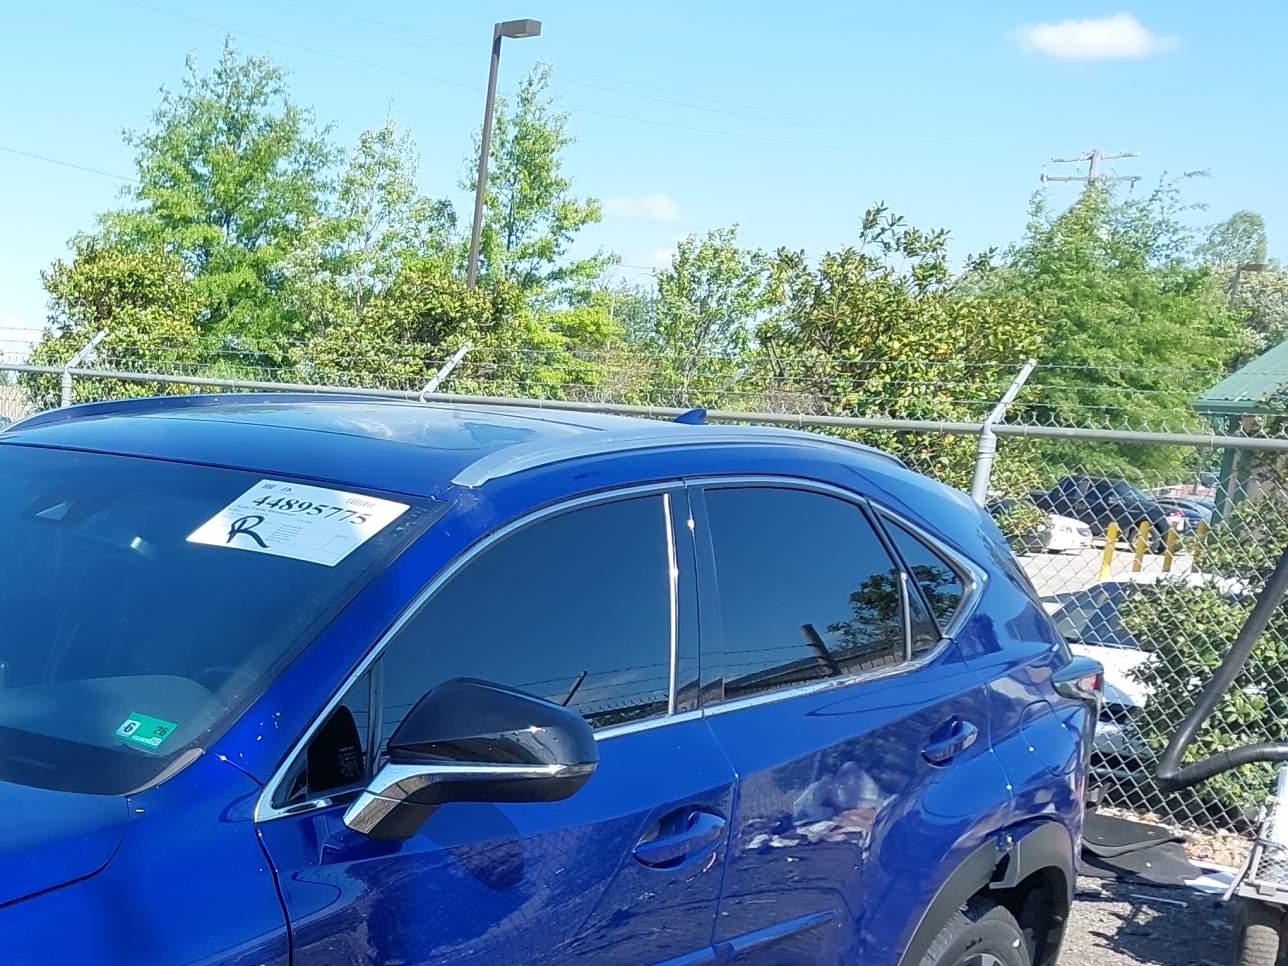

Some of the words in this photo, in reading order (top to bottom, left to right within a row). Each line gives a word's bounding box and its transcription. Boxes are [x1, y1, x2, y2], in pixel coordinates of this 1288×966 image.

[252, 495, 373, 525] 44895775
[226, 515, 271, 549] R
[123, 722, 136, 733] 6
[153, 725, 169, 736] 26
